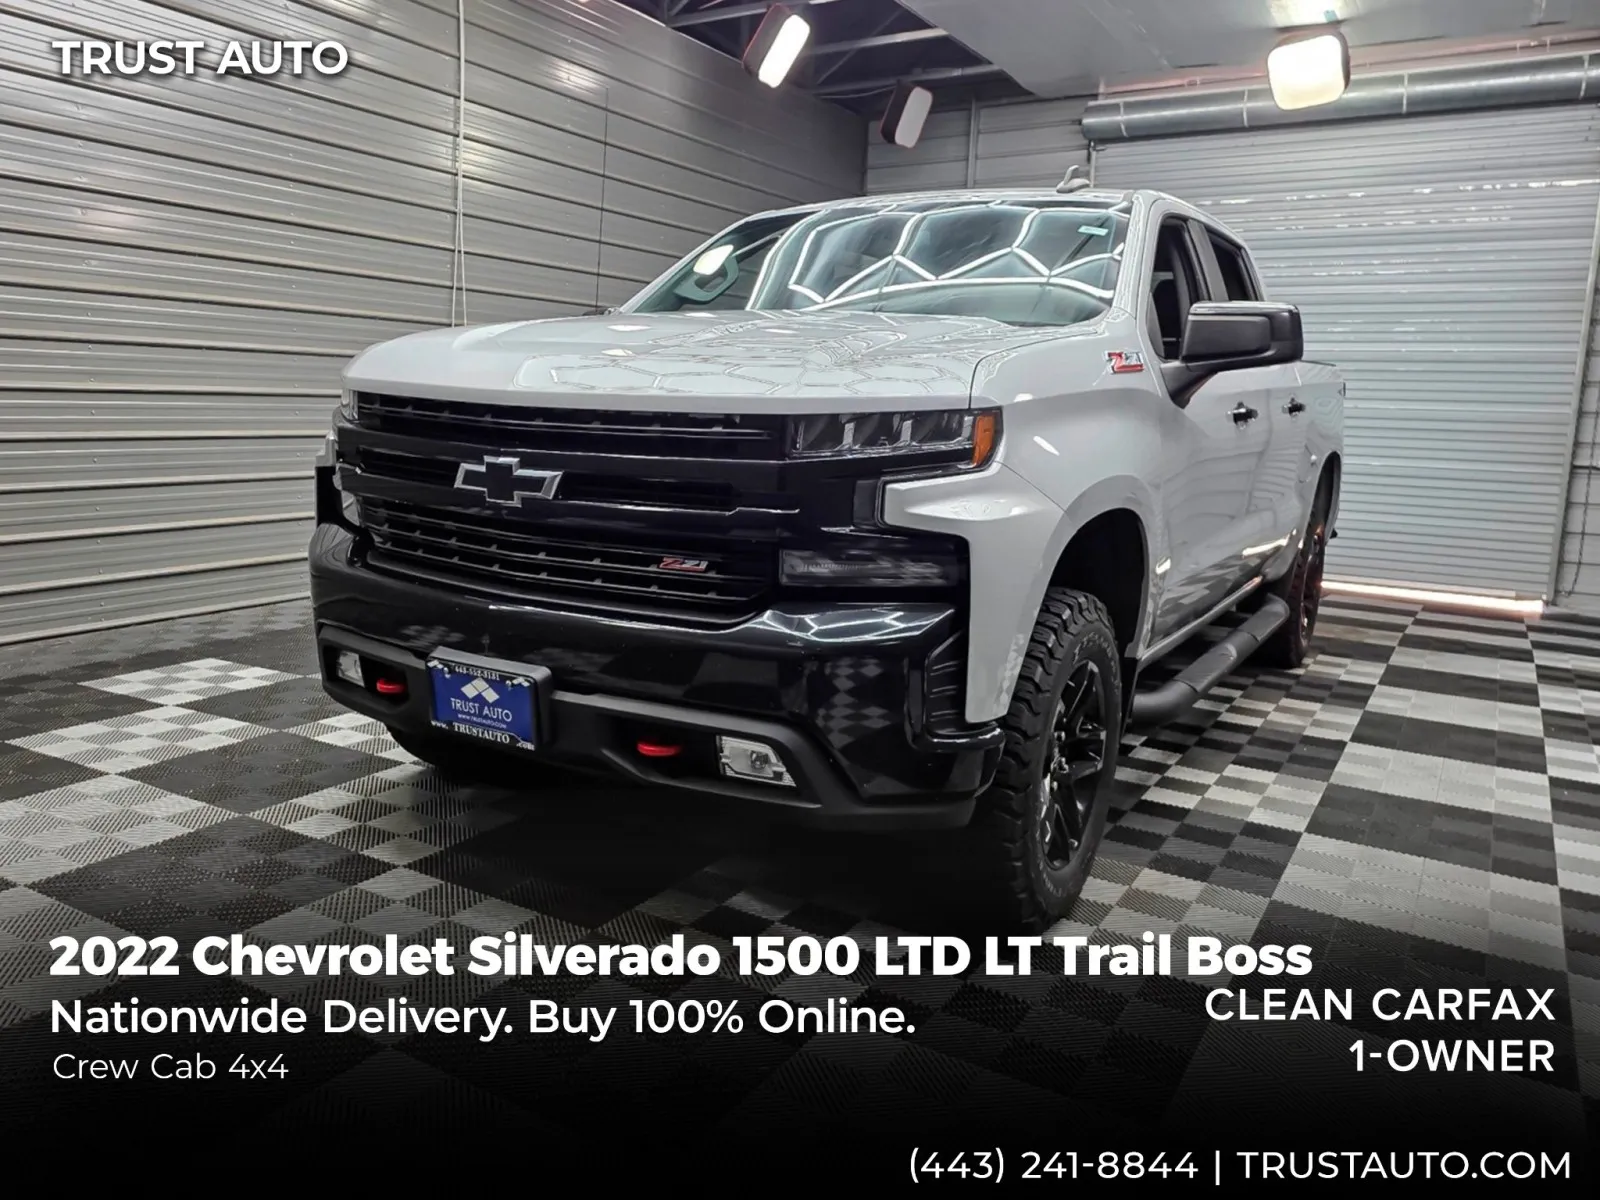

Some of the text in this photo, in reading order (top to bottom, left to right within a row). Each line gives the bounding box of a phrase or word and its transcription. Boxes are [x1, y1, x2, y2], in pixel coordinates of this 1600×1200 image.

[1104, 350, 1145, 374] Z71
[659, 556, 709, 572] Z71
[450, 697, 513, 722] TRUST AUTO
[431, 719, 449, 730] www.
[452, 722, 510, 744] TRUSTAUTO
